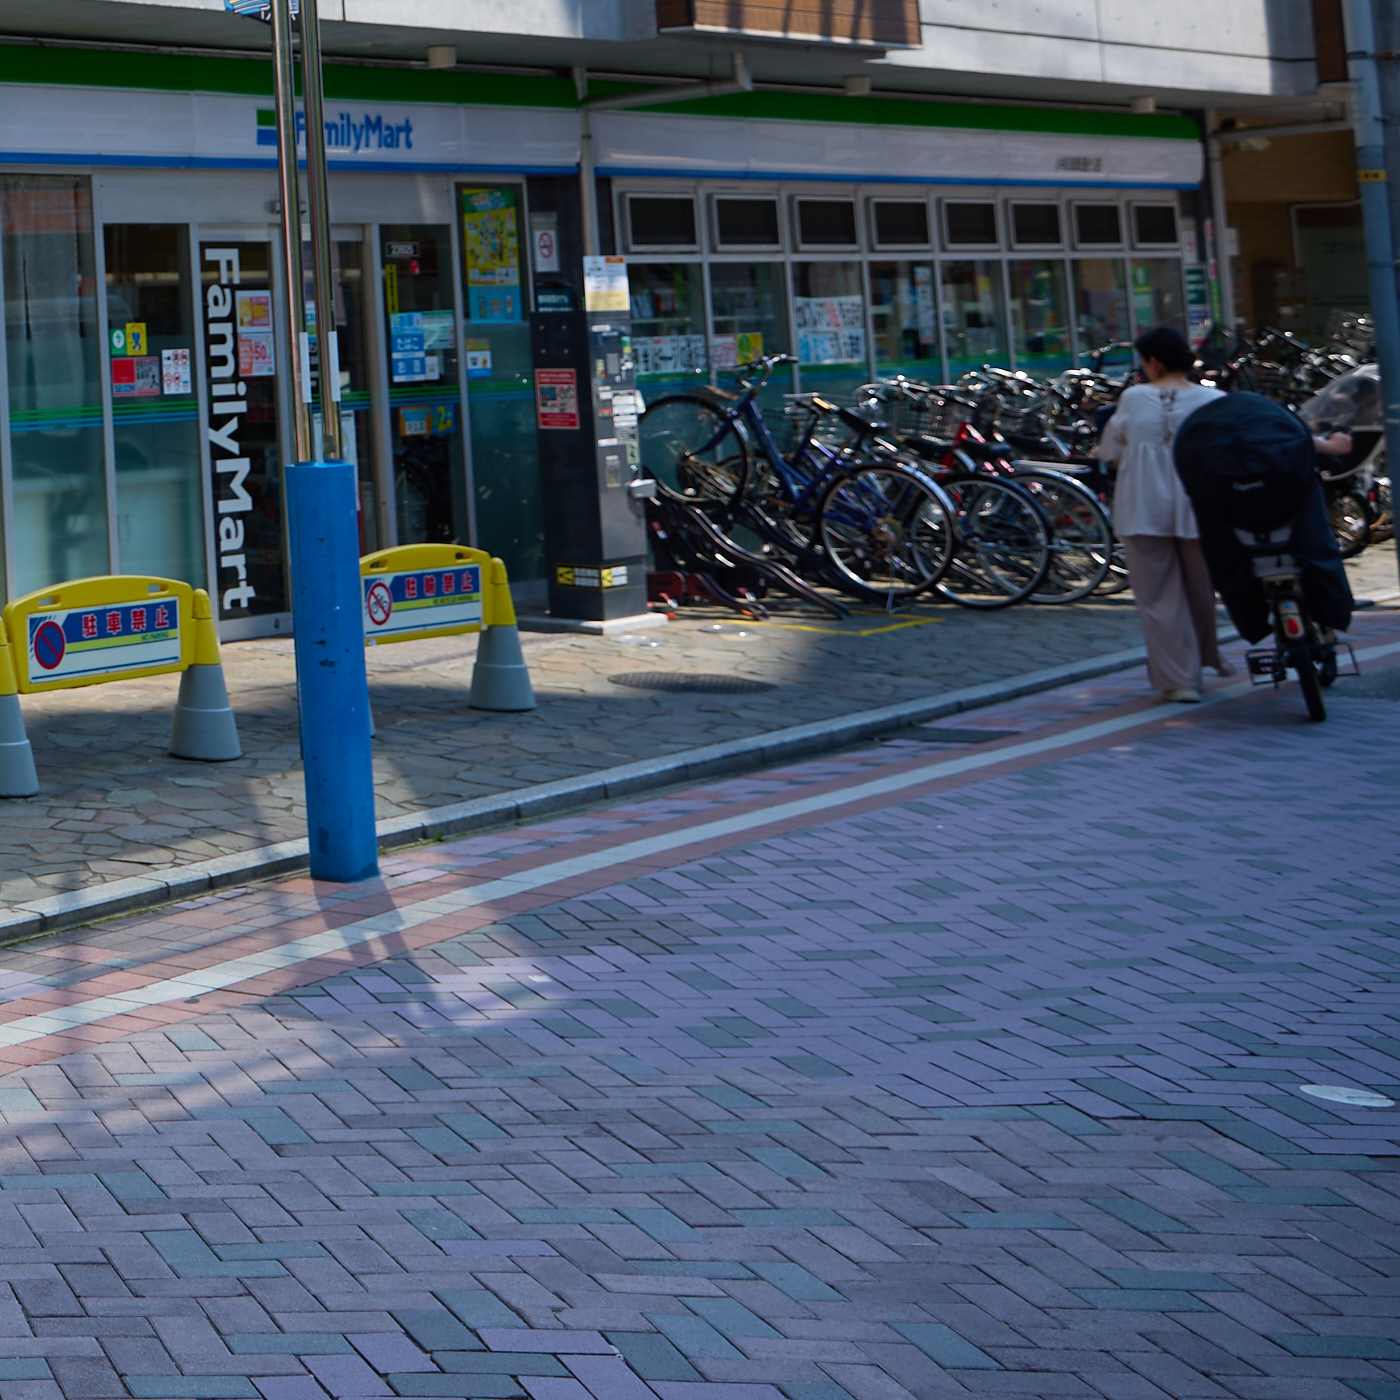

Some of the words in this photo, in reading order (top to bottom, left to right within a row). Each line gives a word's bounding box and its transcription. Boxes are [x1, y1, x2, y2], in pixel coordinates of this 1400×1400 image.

[295, 111, 413, 154] FmilyMart
[204, 247, 257, 612] FamilyMart
[81, 606, 169, 639] 駐車禁止
